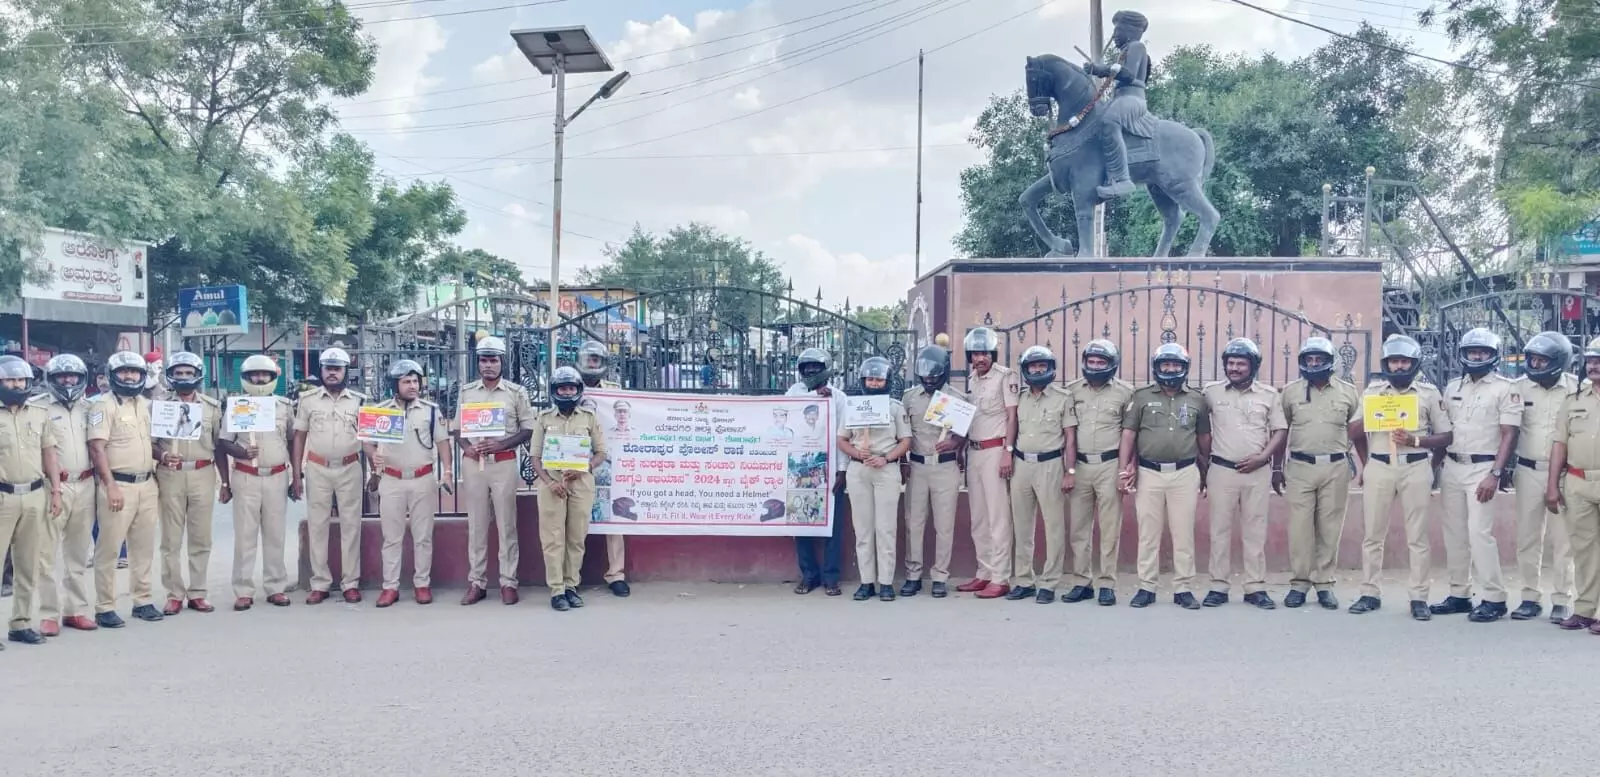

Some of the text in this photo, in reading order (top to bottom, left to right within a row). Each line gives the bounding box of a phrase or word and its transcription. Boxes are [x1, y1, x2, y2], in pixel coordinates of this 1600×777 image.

[193, 290, 225, 300] Amul
[694, 474, 721, 484] 2024
[637, 490, 652, 498] you
[654, 489, 667, 498] got
[675, 489, 697, 498] head,
[699, 489, 713, 497] You
[715, 489, 736, 498] need
[708, 512, 715, 520] it
[715, 512, 735, 521] Every
